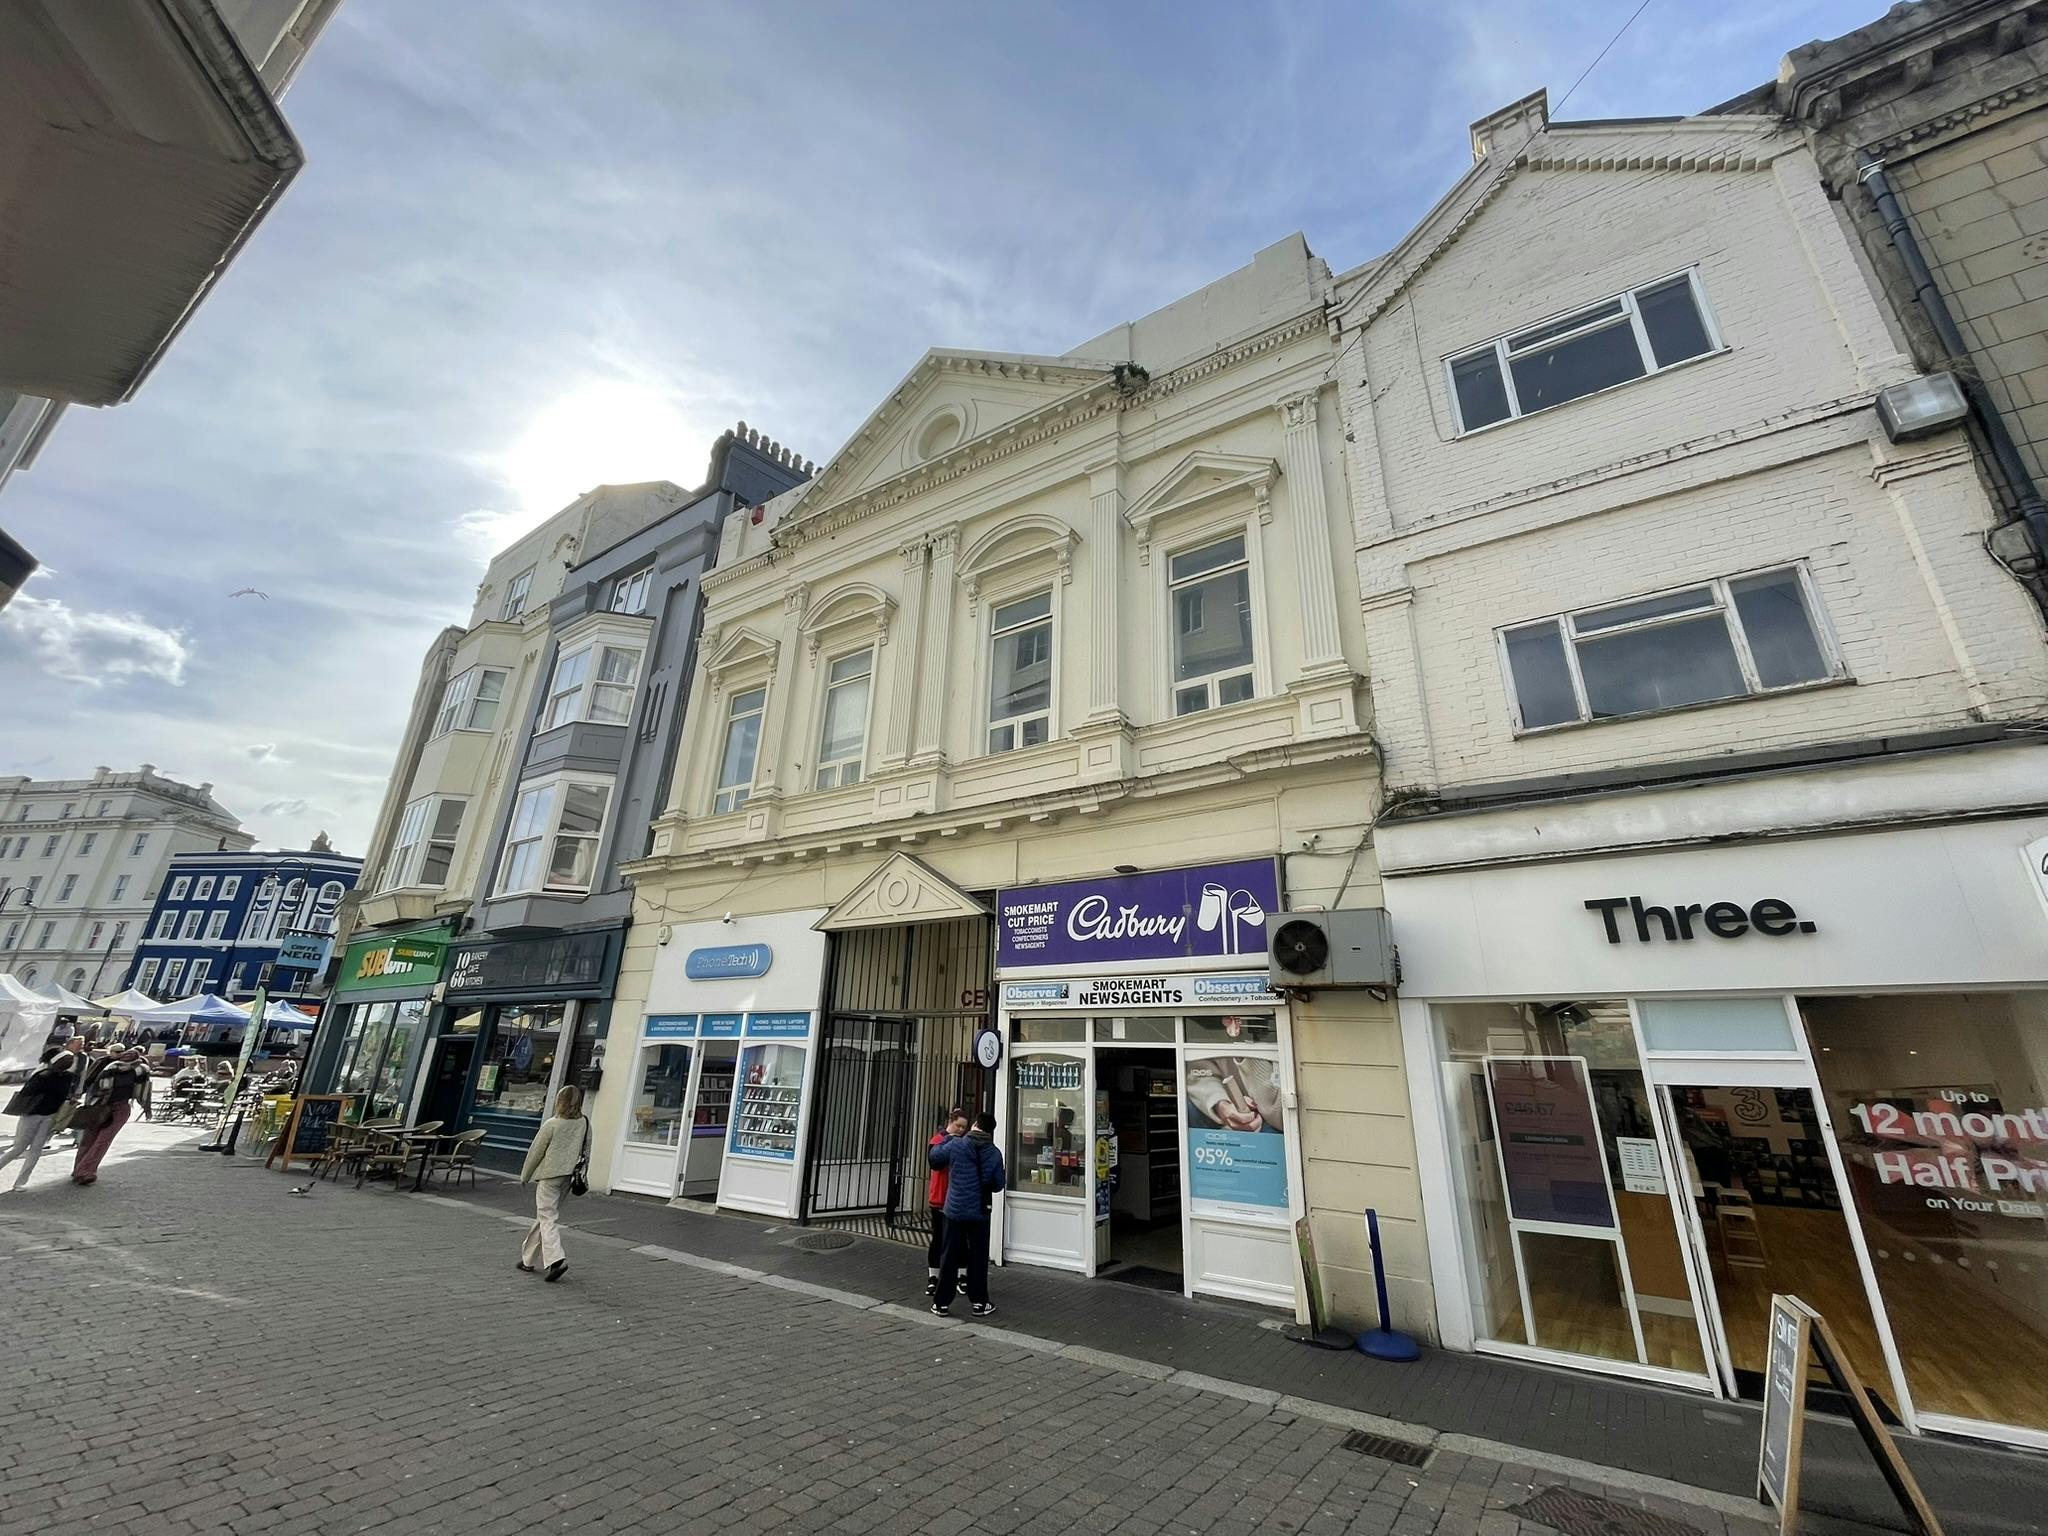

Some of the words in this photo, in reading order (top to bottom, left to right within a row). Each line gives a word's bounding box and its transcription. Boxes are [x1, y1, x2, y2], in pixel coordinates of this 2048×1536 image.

[1004, 901, 1059, 916] SMOKEMART
[1007, 916, 1025, 928] CUT
[1028, 914, 1055, 926] PRICE
[1067, 895, 1186, 944] Cadbury
[1584, 896, 1817, 943] Three.
[281, 950, 322, 961] NERO
[455, 951, 470, 970] 10
[450, 970, 466, 988] 66
[1092, 979, 1167, 991] SMOKEMART
[1195, 980, 1260, 994] Observer
[1007, 986, 1057, 999] Observer
[1079, 989, 1183, 1005] NEWSAGENTS
[1940, 1090, 1967, 1105] Up
[1970, 1092, 1989, 1103] to
[1850, 1103, 1904, 1134] 12
[1195, 1147, 1233, 1166] 95%
[1873, 1152, 1971, 1189] Half
[1926, 1198, 1949, 1210] on
[1951, 1197, 1994, 1212] Your
[1997, 1200, 2043, 1215] Data
